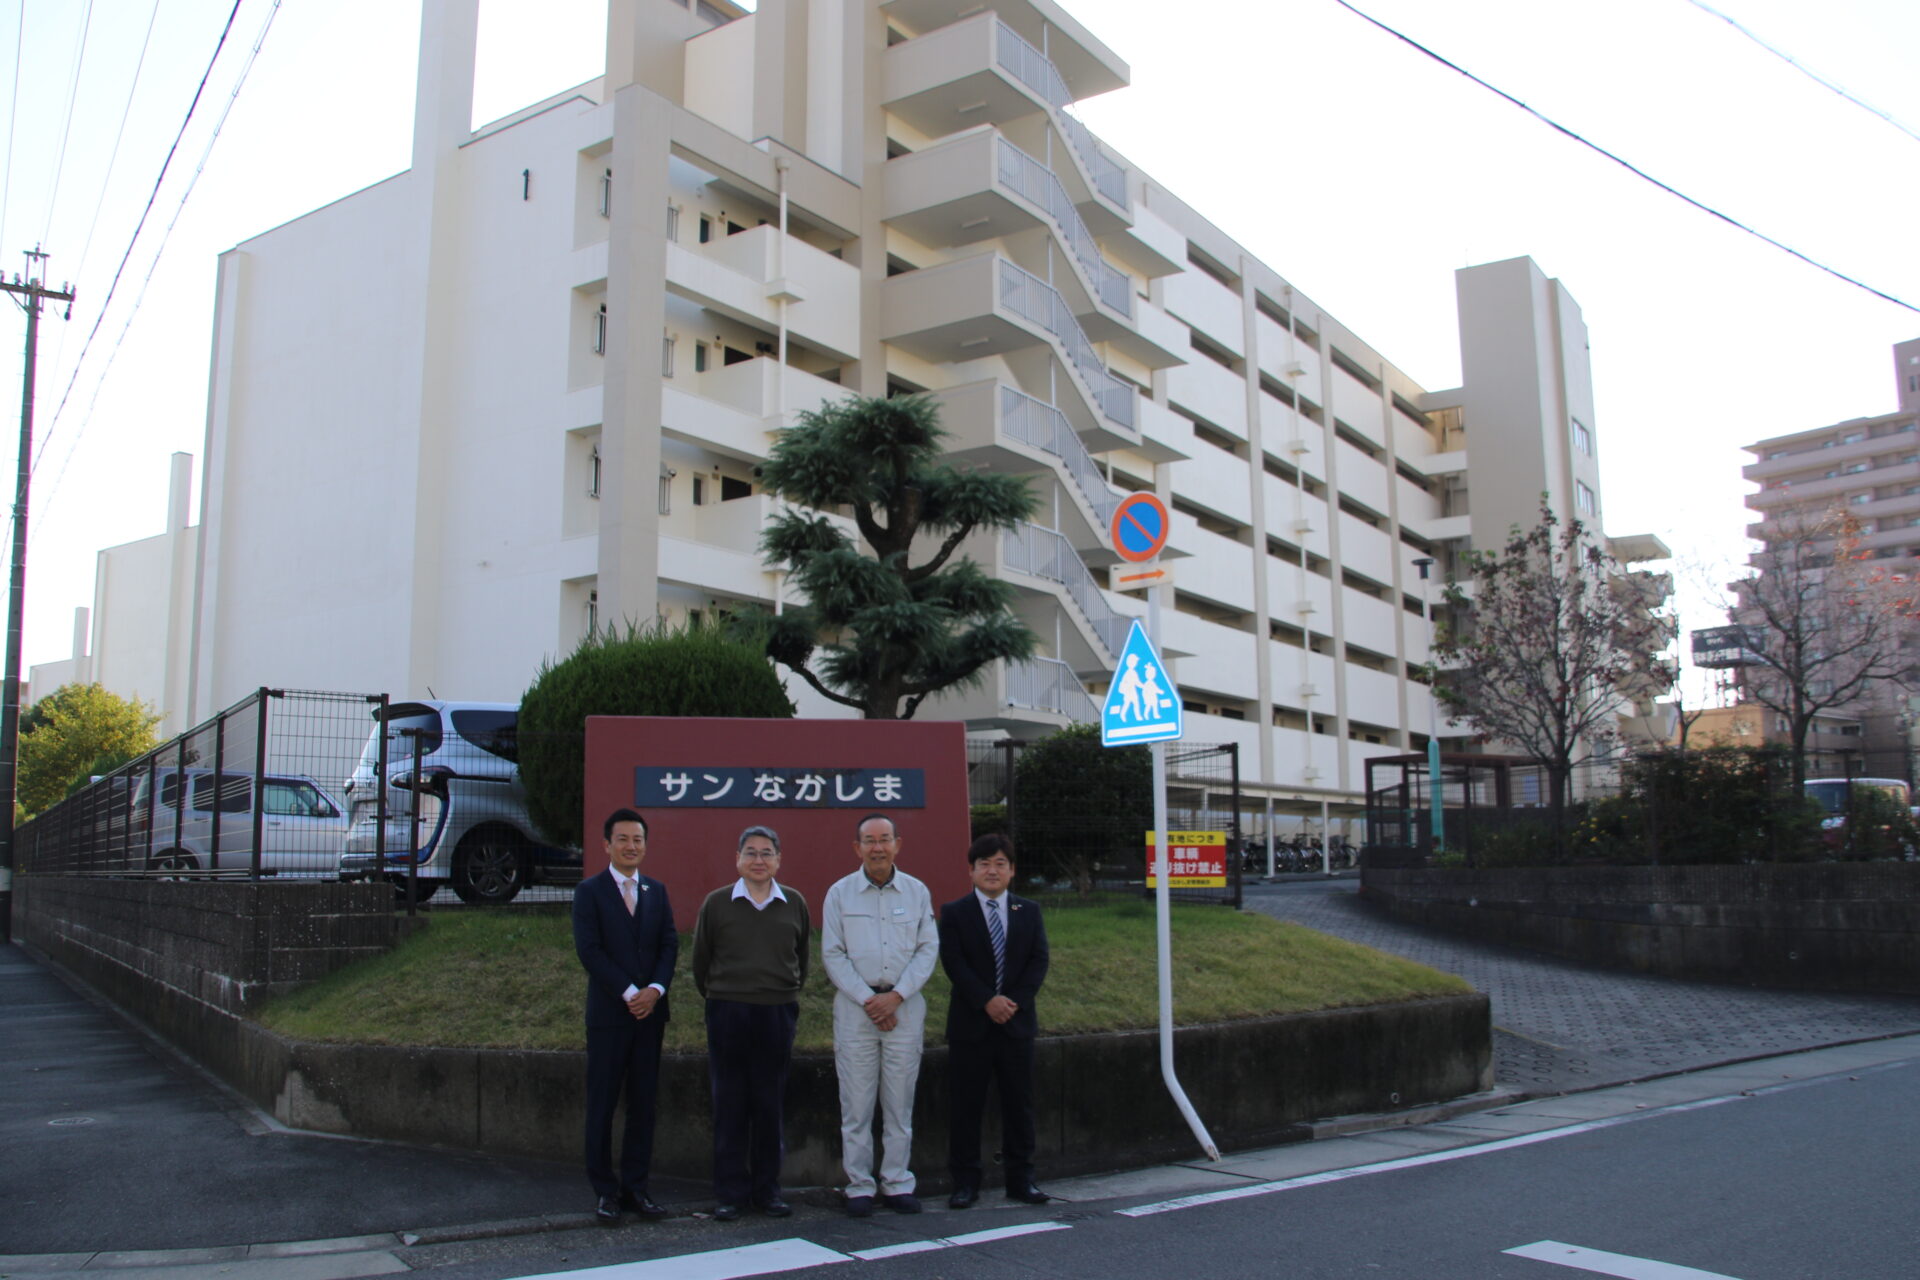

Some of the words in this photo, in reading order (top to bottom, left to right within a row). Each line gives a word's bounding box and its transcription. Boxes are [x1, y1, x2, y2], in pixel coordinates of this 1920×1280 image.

[659, 772, 734, 801] サン
[753, 773, 903, 802] なかしま
[1167, 834, 1215, 844] 有地につき
